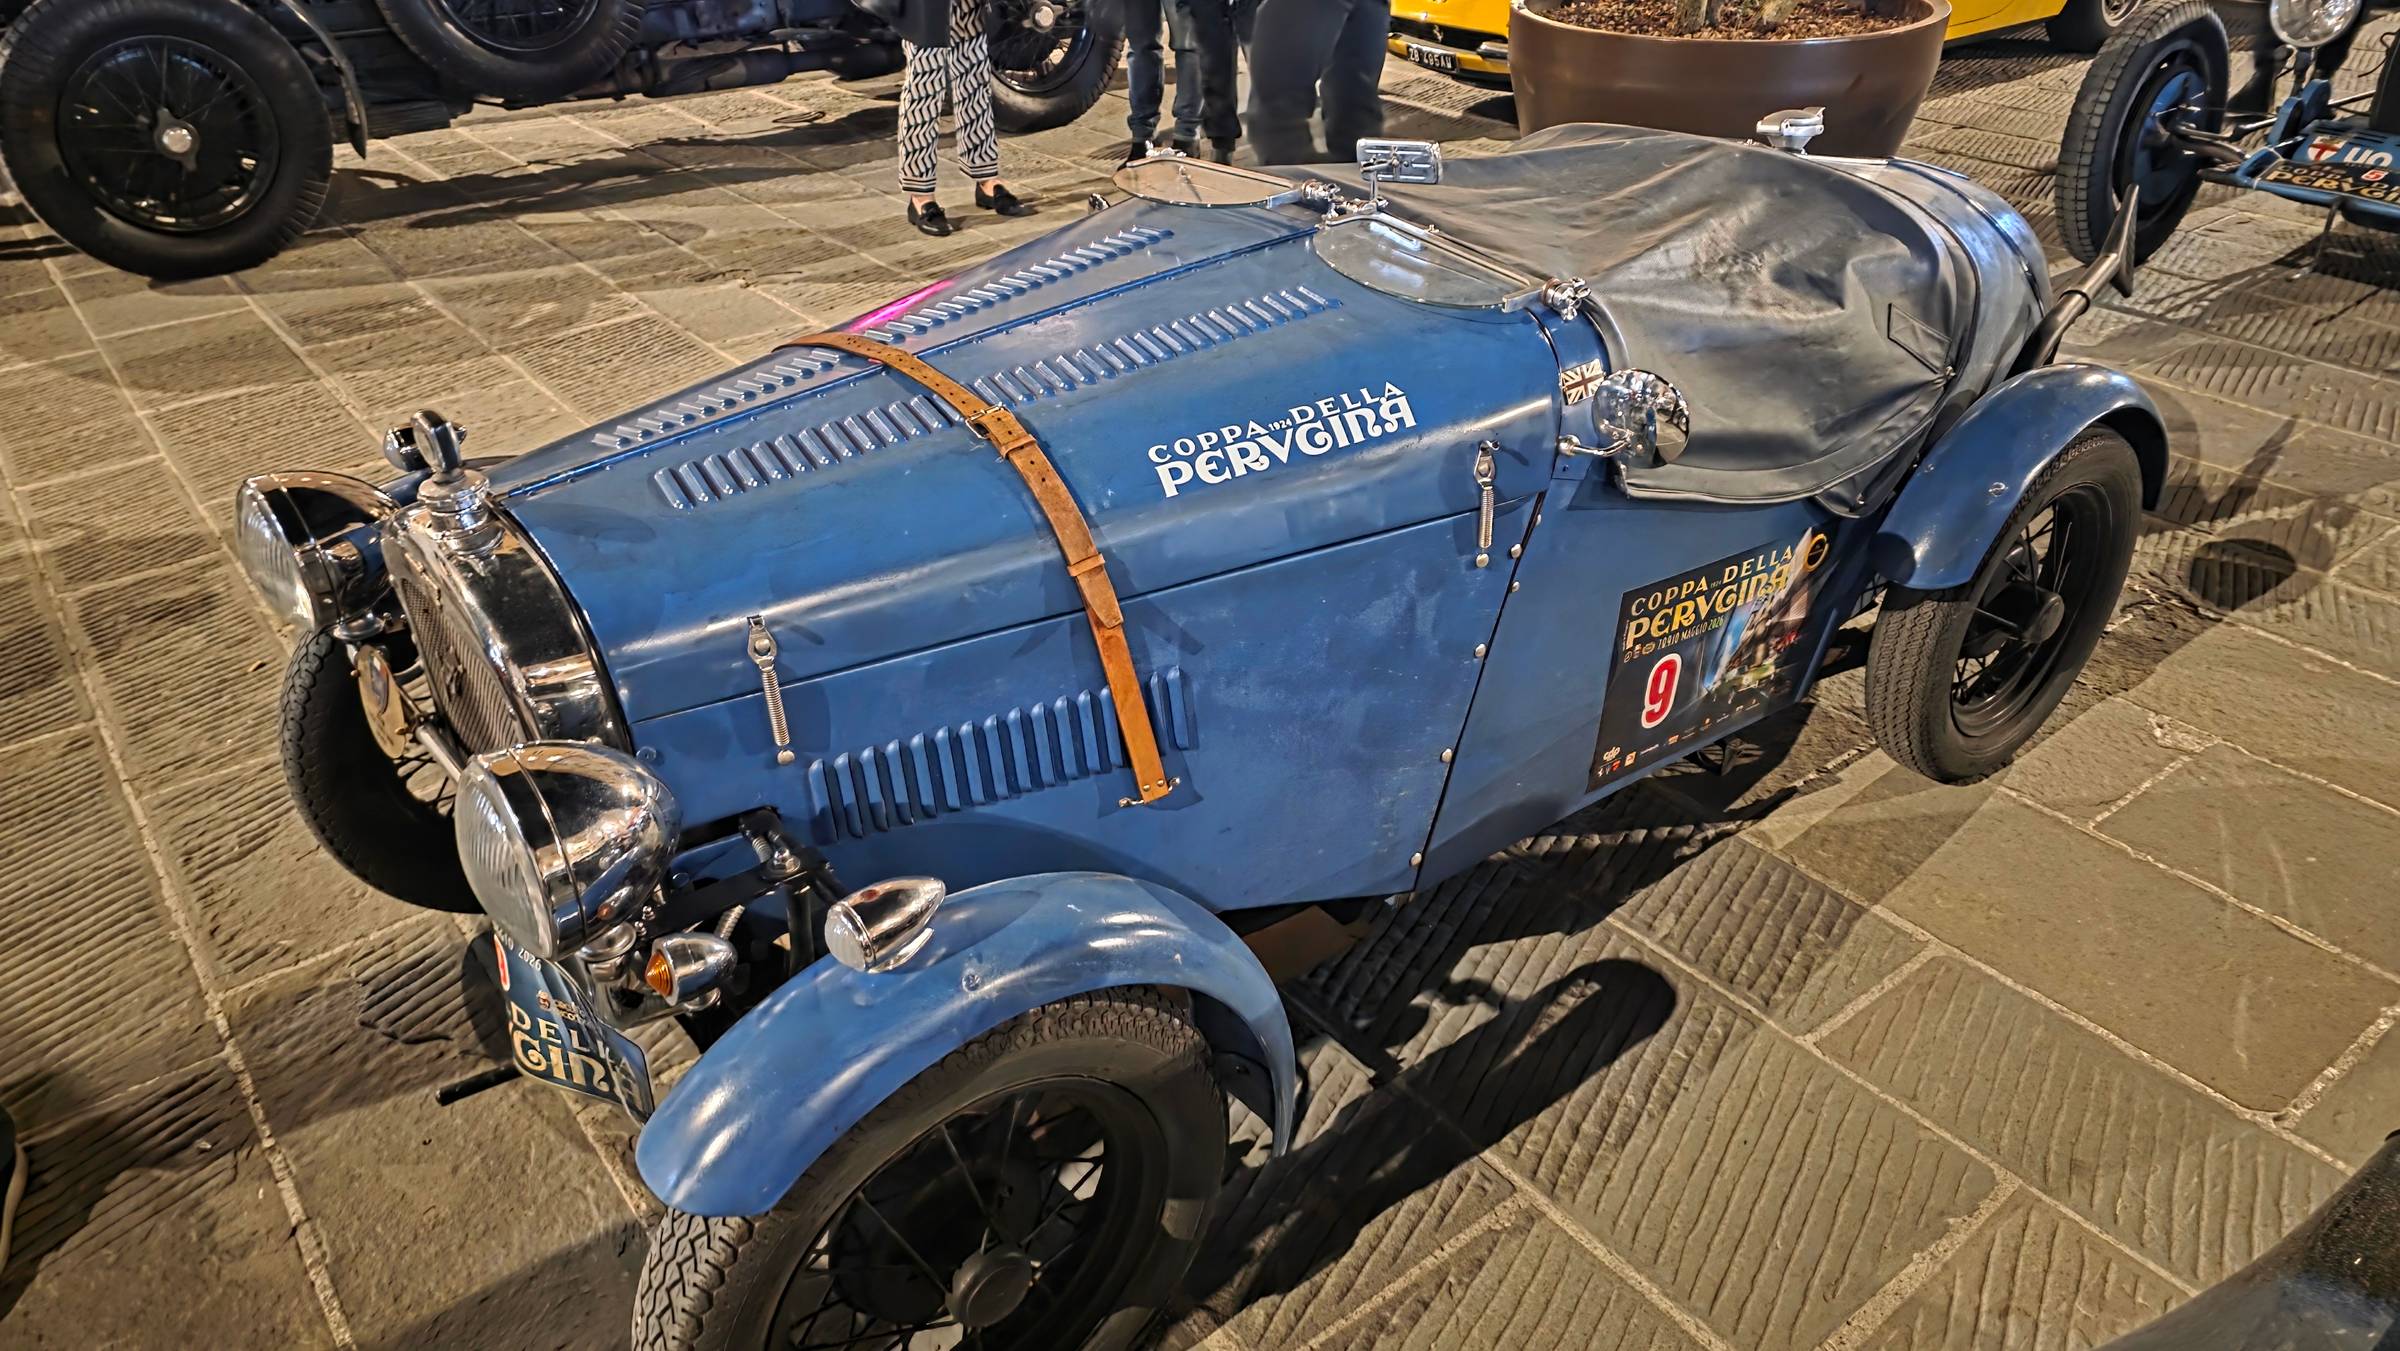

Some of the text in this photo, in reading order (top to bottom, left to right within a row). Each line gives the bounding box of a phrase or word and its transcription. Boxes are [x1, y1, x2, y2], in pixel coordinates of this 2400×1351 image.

[1148, 381, 1405, 463] COPPA 1924 DELLA
[1631, 576, 1708, 617] COPPA
[1723, 545, 1793, 584] DELLA
[1681, 621, 1708, 641] MAGGIO
[1708, 615, 1725, 631] 2026
[1641, 652, 1682, 729] 9
[518, 948, 543, 972] 2026
